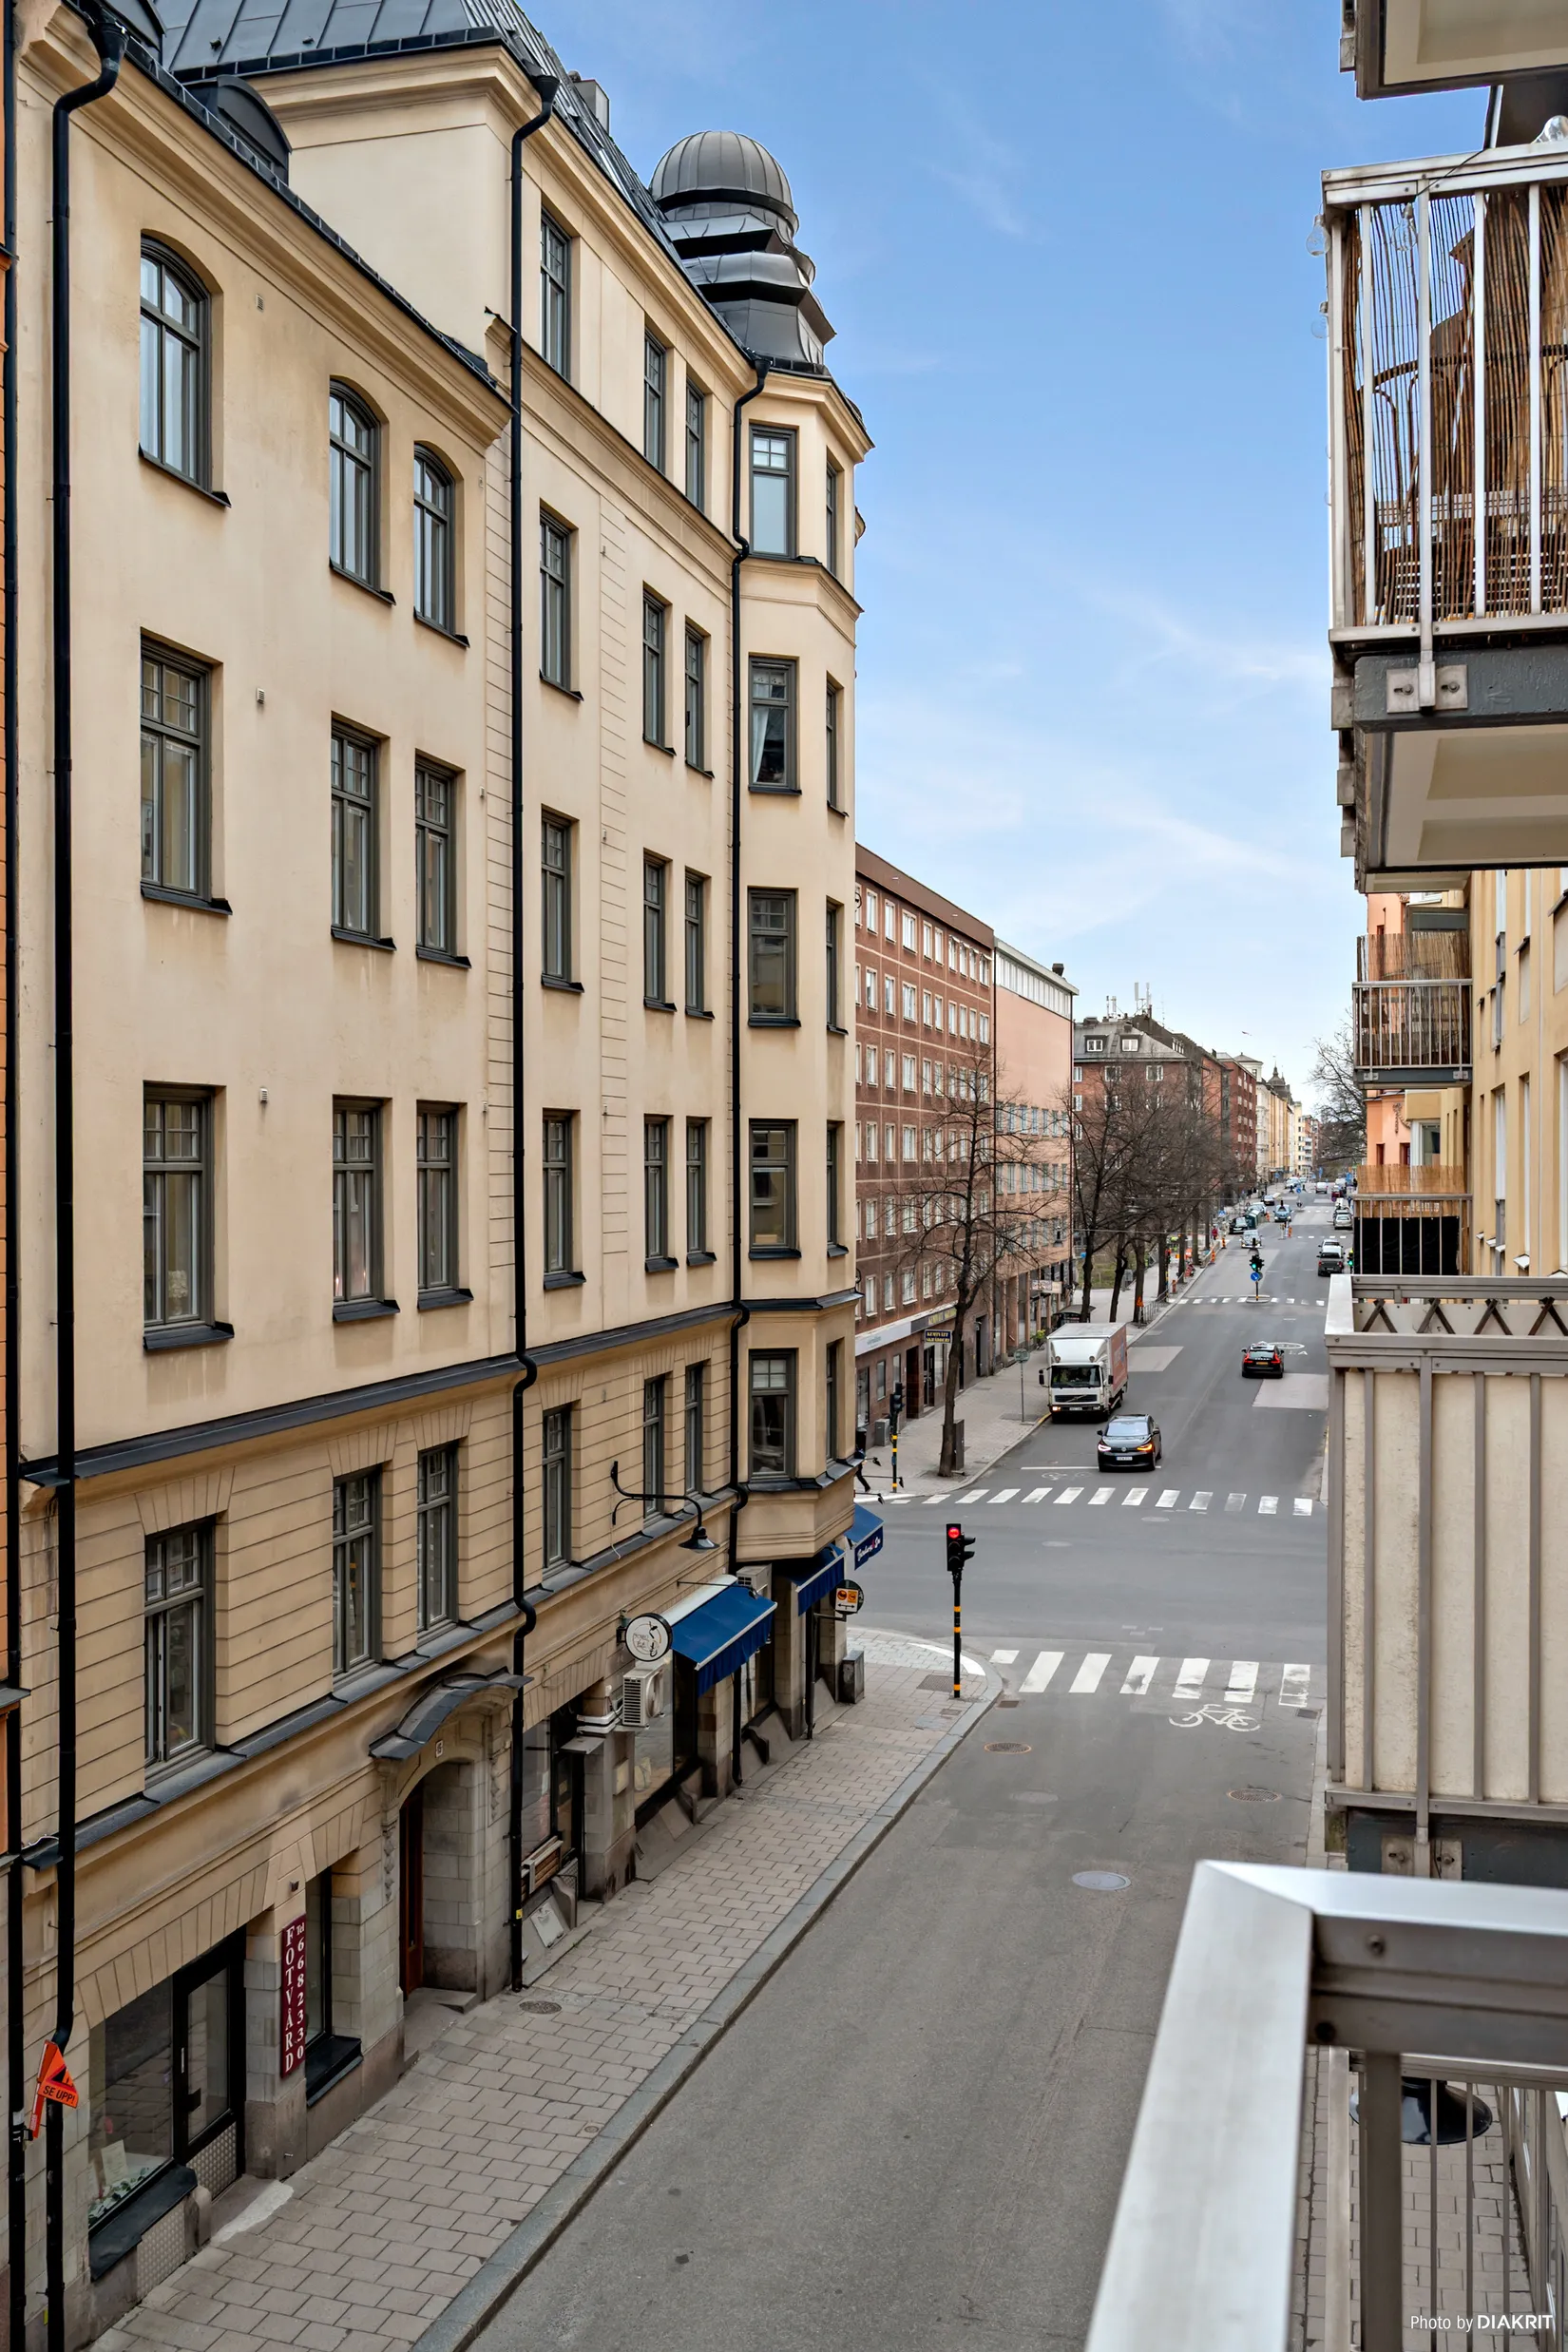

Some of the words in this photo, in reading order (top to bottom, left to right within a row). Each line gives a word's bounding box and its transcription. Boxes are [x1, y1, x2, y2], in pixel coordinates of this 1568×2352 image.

[296, 1922, 305, 1936] Tel
[285, 1924, 296, 2073] FOTVÅRD
[296, 1937, 305, 2059] 6682330
[42, 2085, 56, 2096] SE
[55, 2089, 76, 2105] UPP!
